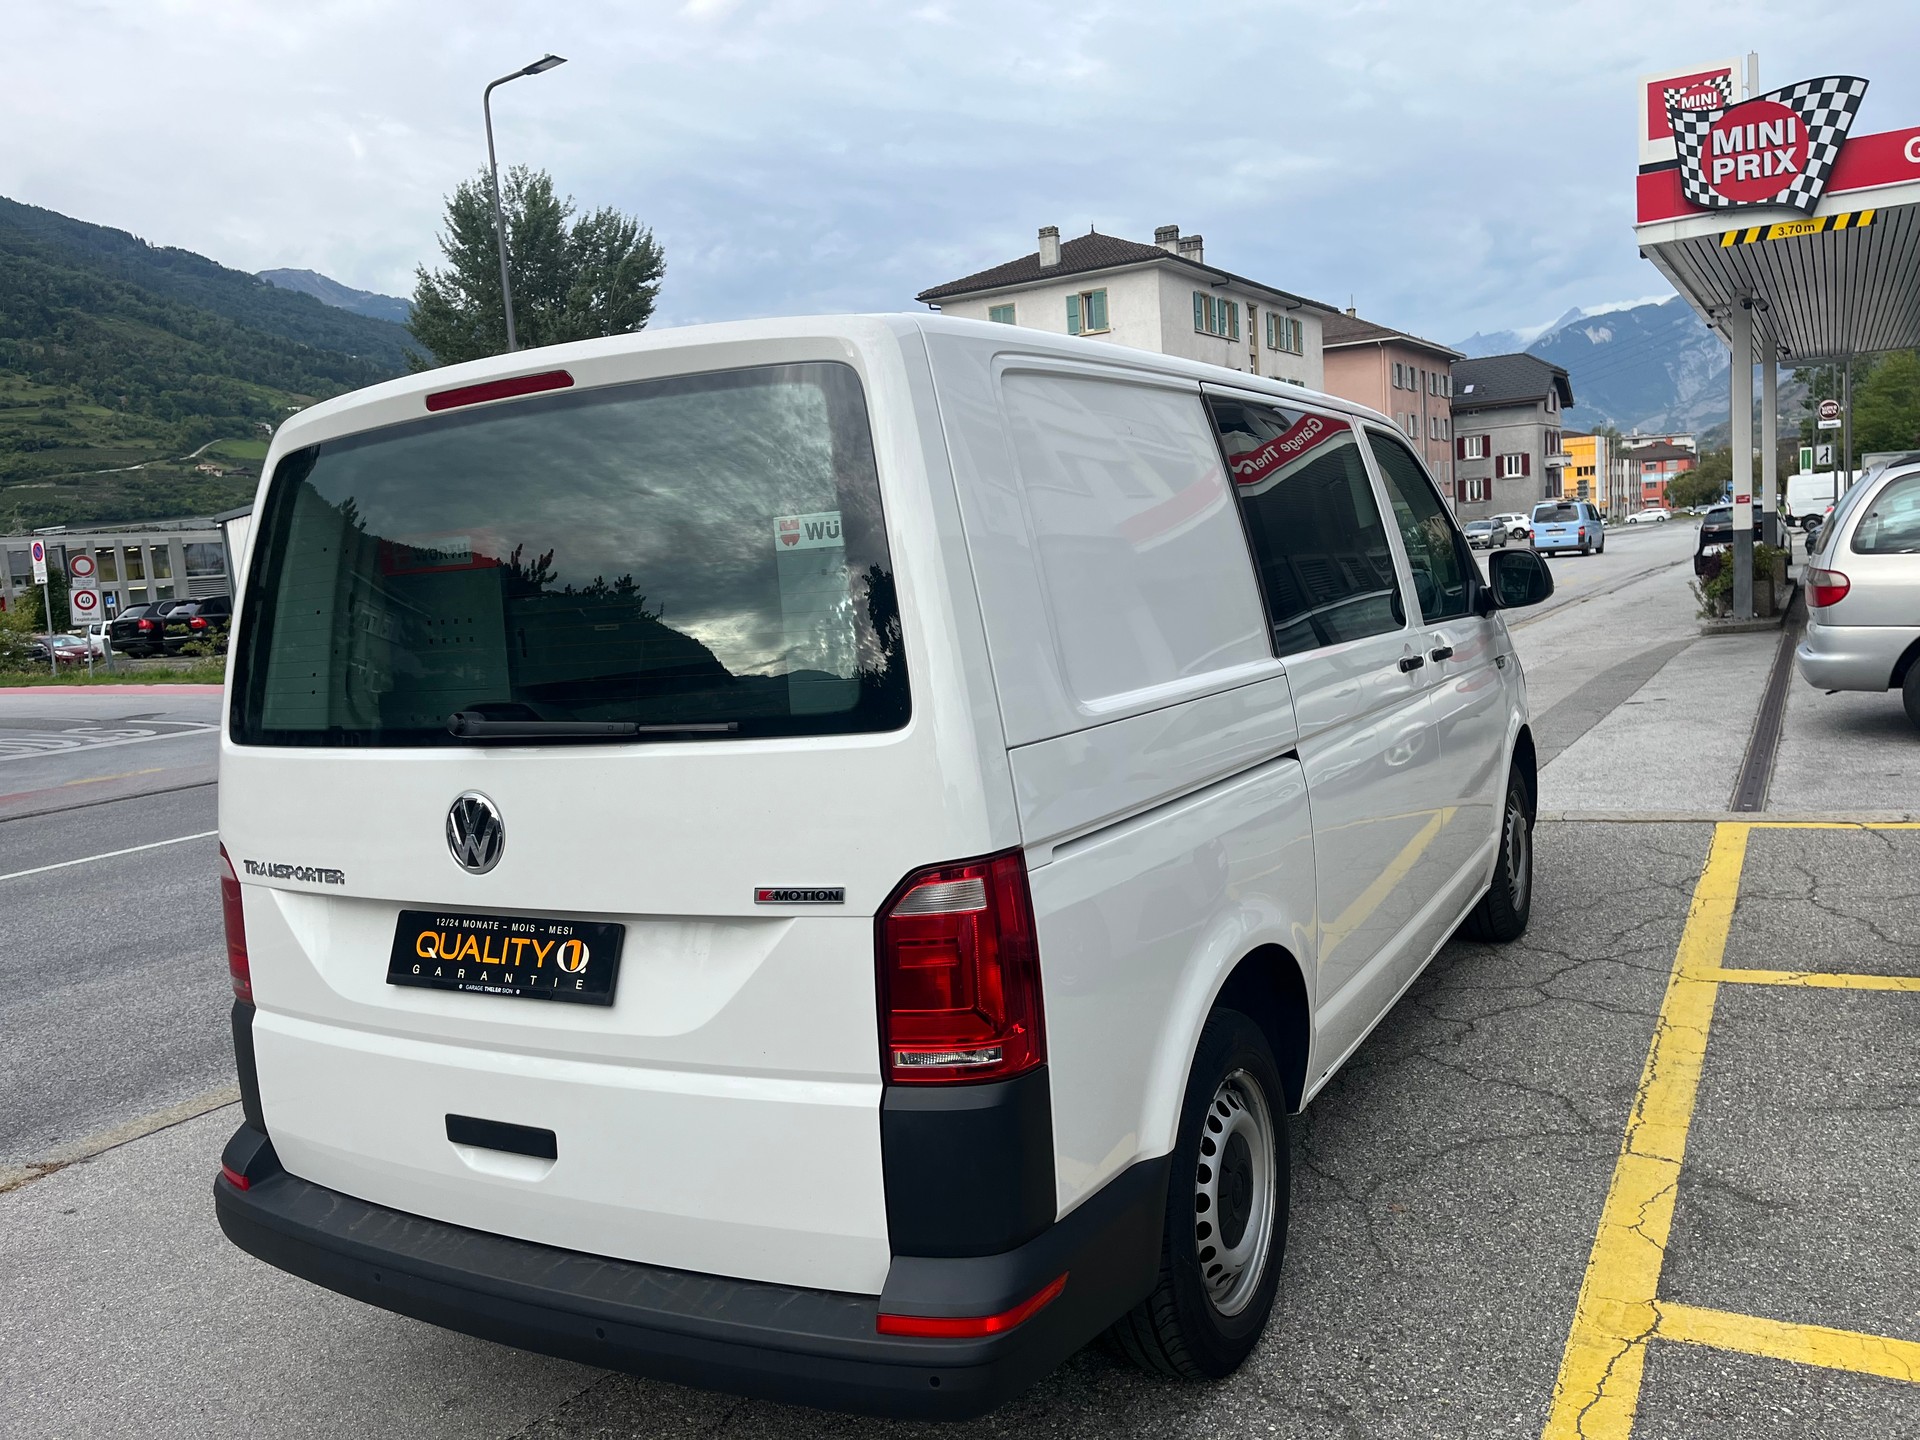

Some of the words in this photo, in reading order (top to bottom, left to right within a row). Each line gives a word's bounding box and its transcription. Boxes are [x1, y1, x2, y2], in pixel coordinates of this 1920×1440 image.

[1681, 91, 1718, 109] MINI
[1711, 116, 1797, 157] MINI
[1711, 146, 1799, 185] PRIX
[81, 596, 91, 605] 40
[243, 859, 346, 885] TRANSPORTER
[436, 918, 459, 928] 12/24
[462, 919, 500, 931] MONATE
[511, 923, 536, 933] MOIS
[548, 925, 573, 936] MESI
[415, 930, 556, 969] QUALITY
[465, 984, 484, 992] GARAGE
[502, 987, 514, 995] SION
